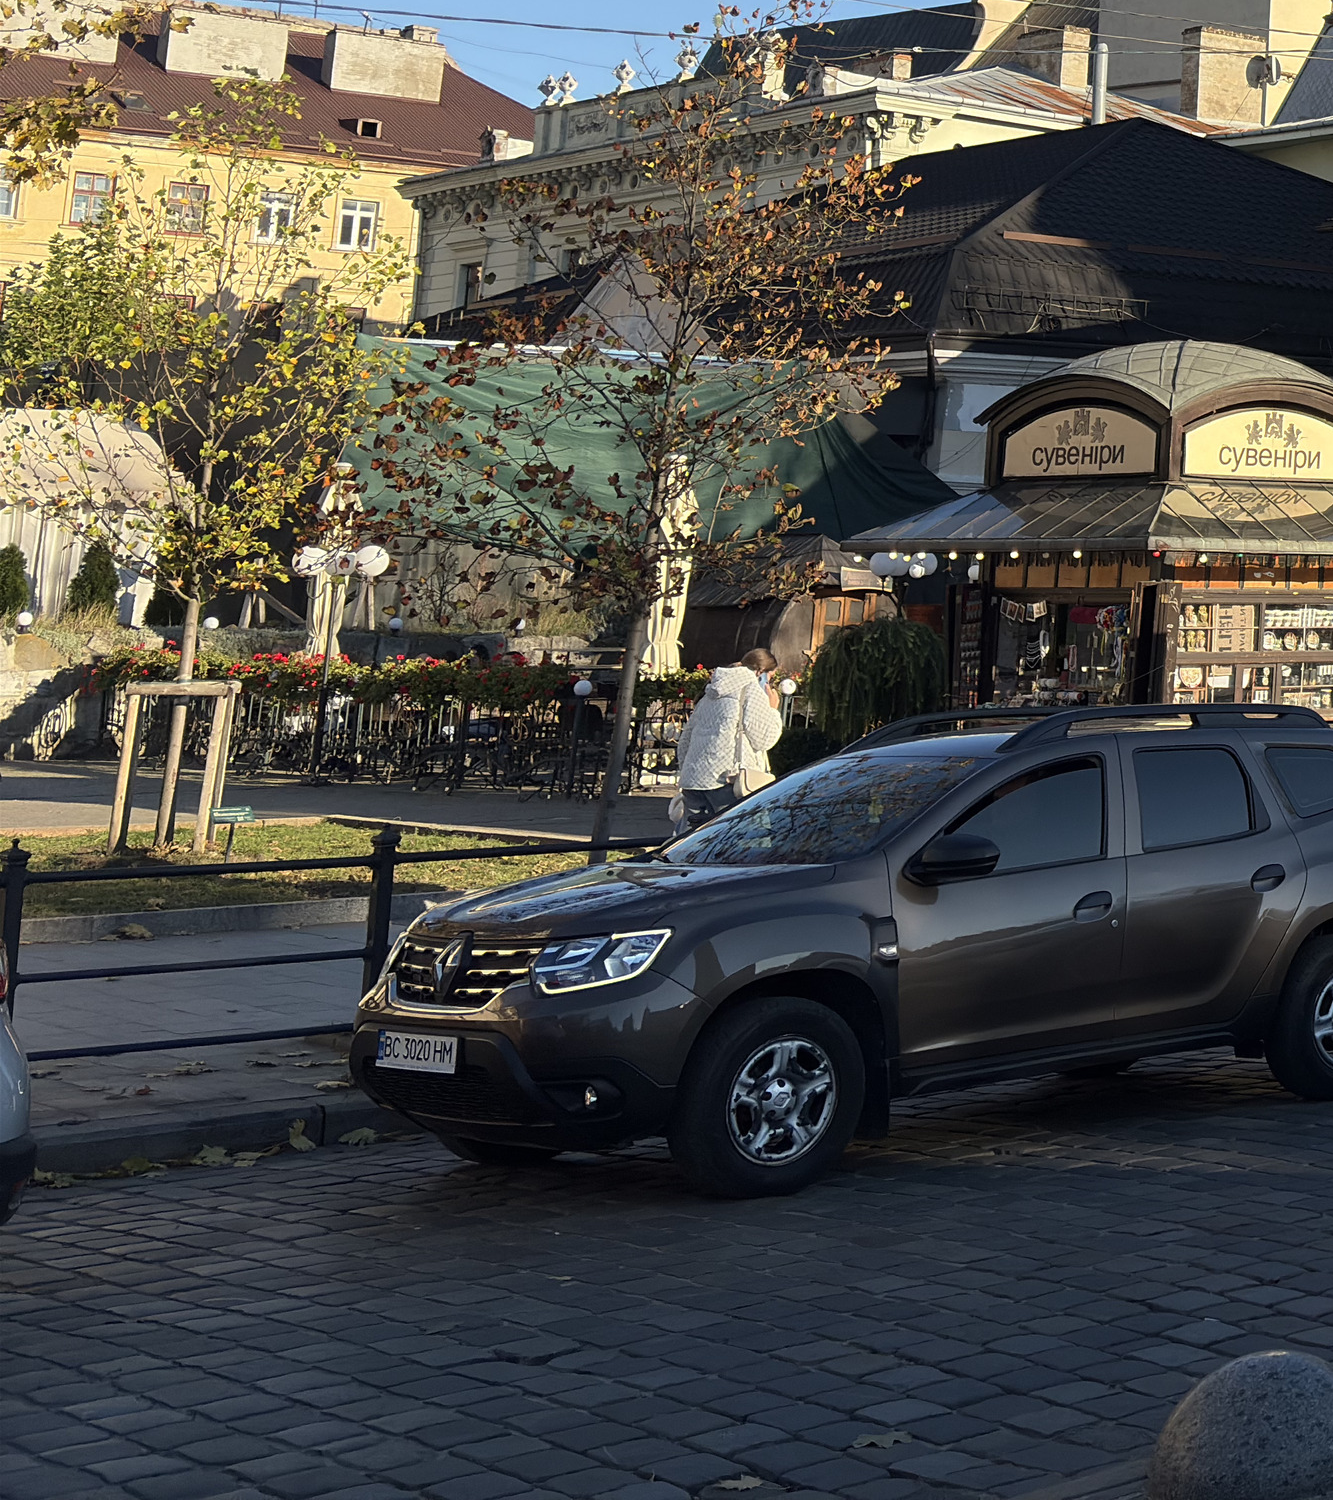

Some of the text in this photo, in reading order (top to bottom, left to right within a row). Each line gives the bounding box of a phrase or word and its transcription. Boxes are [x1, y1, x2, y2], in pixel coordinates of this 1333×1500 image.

[1032, 443, 1125, 473] сувеніри
[1219, 443, 1321, 475] сувеніри
[384, 1035, 454, 1064] BC 3020 HM
